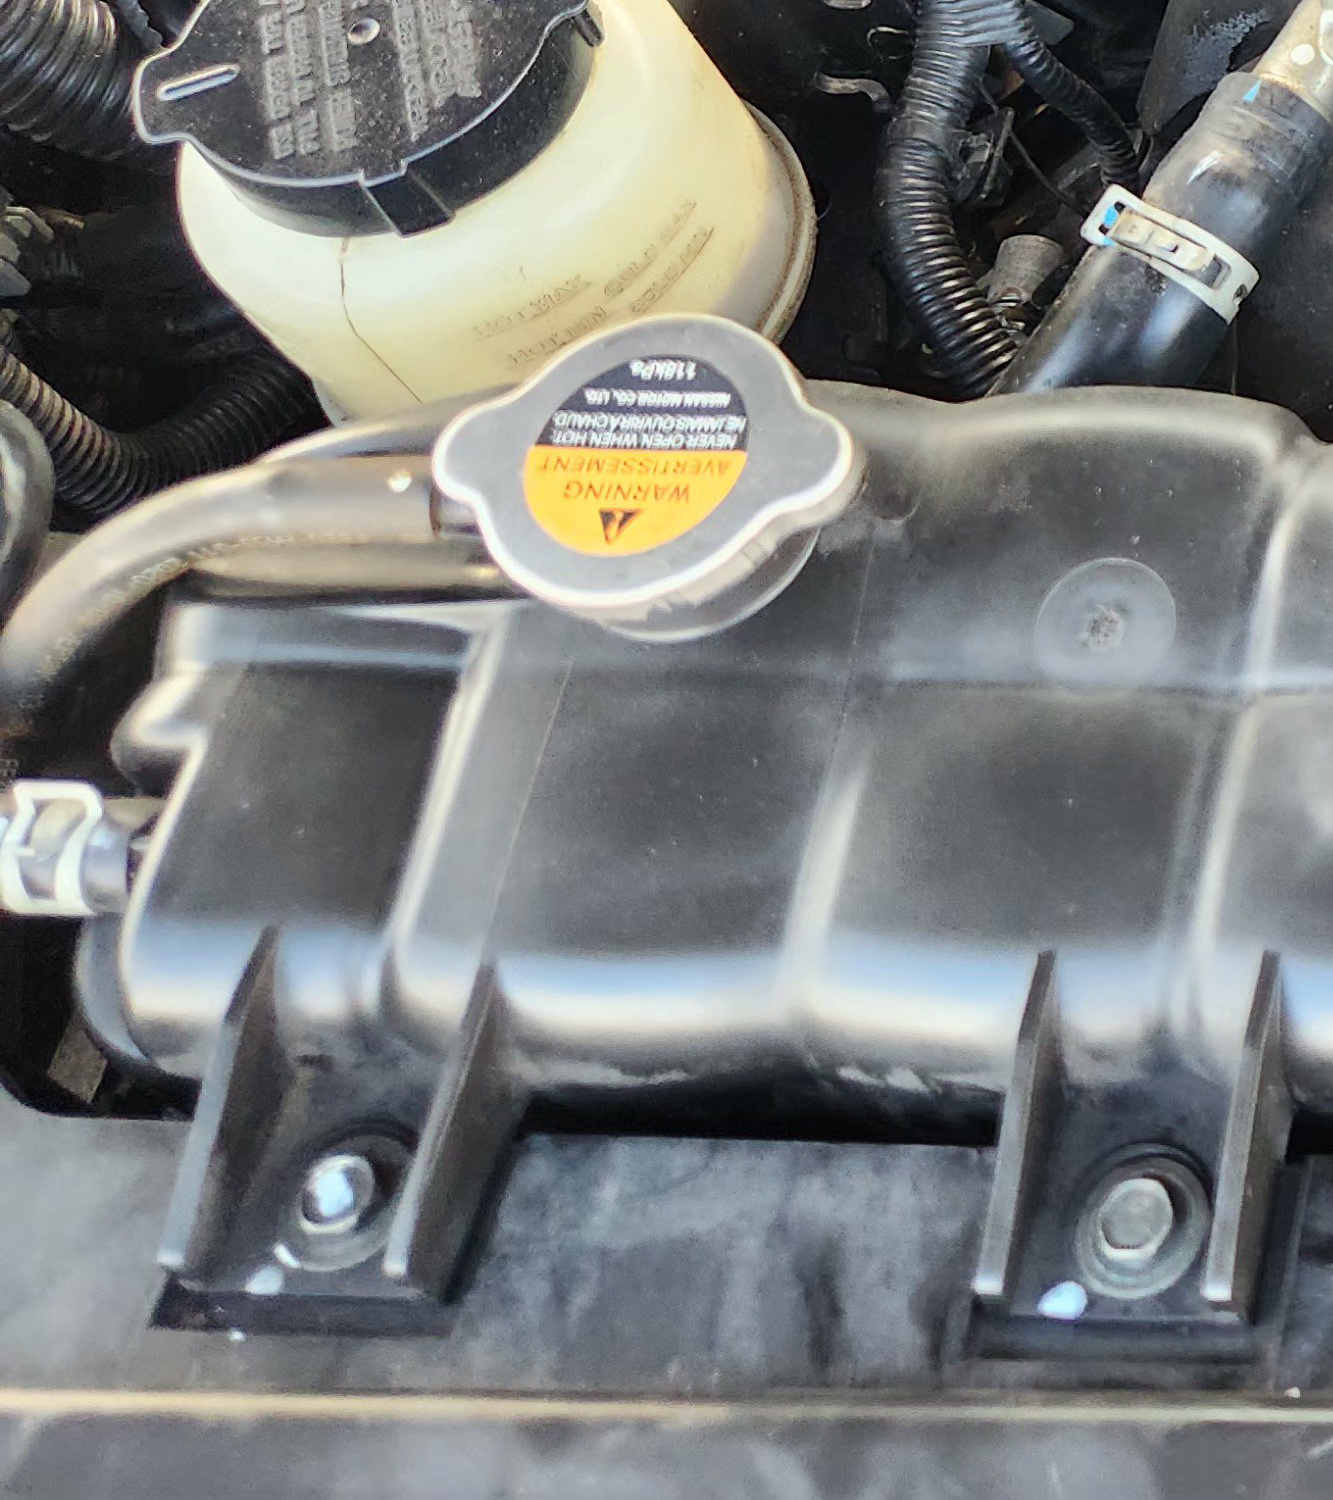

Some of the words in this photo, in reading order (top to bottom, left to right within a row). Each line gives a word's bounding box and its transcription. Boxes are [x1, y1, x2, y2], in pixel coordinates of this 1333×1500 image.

[630, 361, 696, 380] 118kPa
[638, 392, 682, 407] MOTOR
[591, 432, 638, 446] WHEN
[642, 433, 684, 447] OPEN
[686, 434, 737, 449] NEVER
[536, 457, 731, 476] AVERTISSEMENT
[563, 481, 691, 502] WARNING
